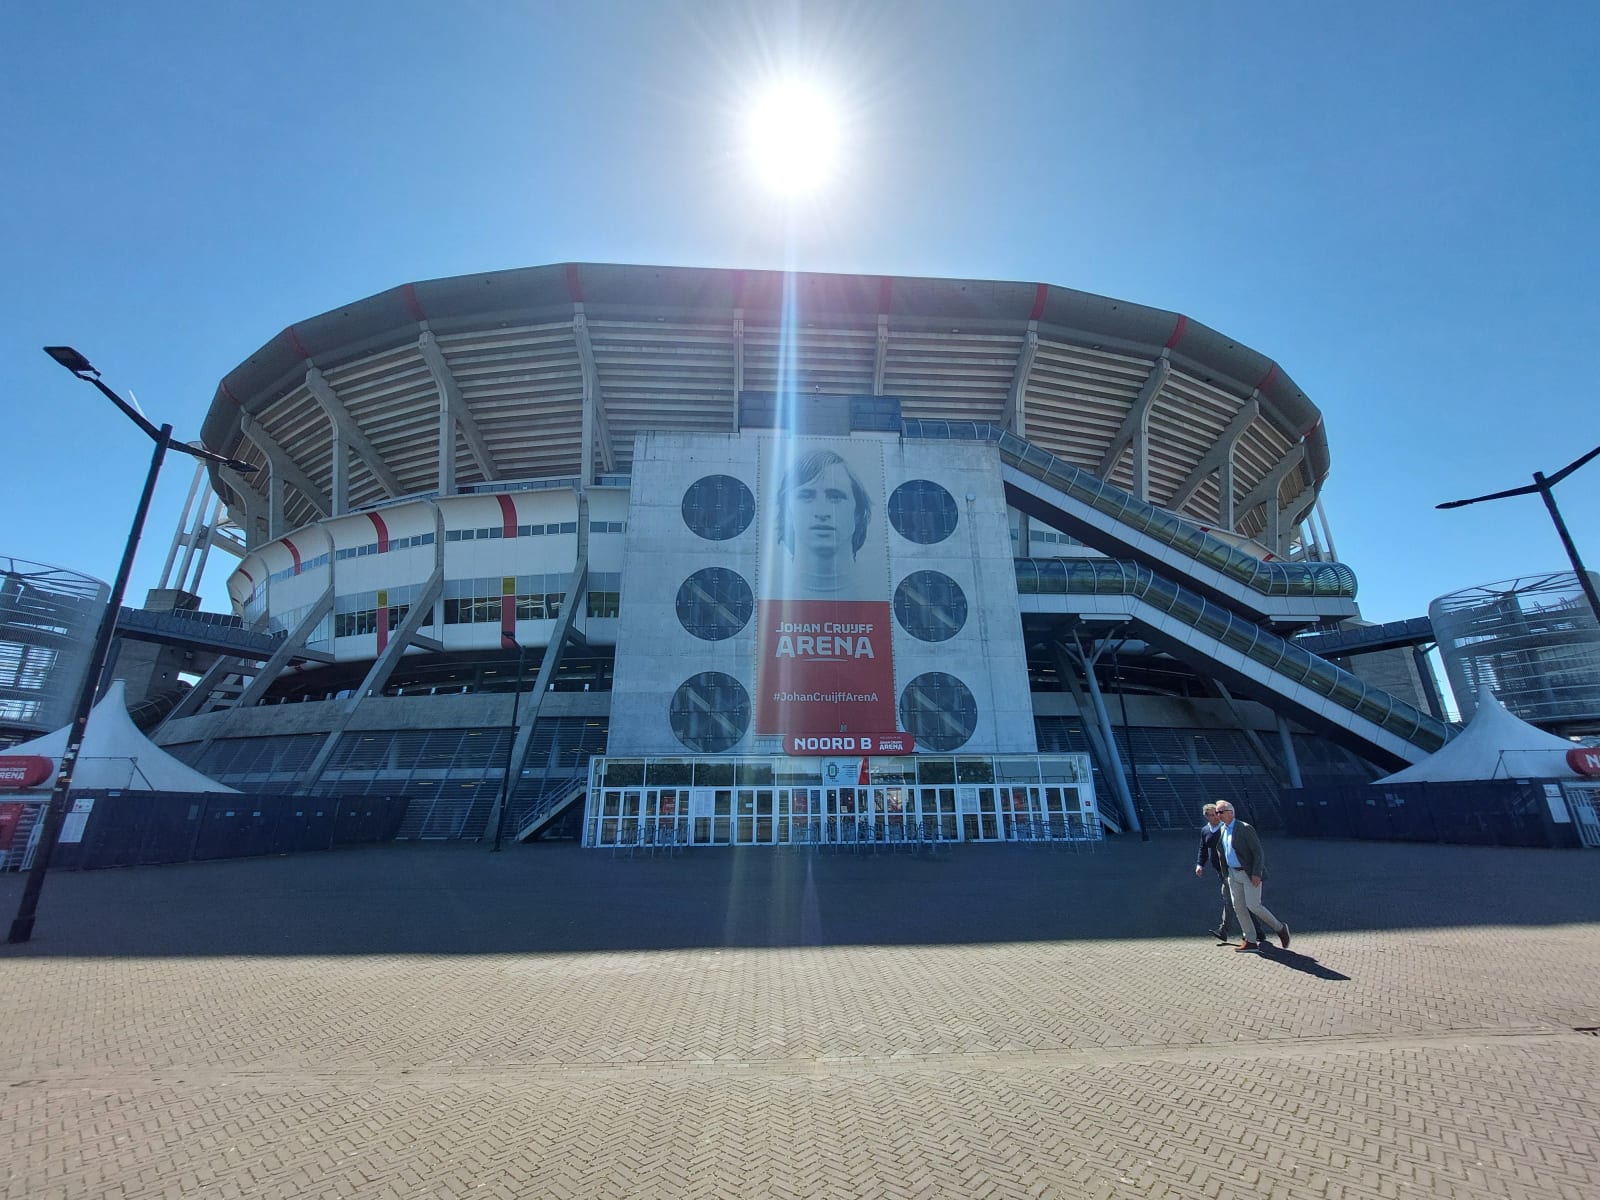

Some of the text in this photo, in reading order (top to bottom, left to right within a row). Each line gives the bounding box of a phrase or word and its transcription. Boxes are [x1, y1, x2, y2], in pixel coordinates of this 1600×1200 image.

[776, 622, 820, 633] JOHAN
[776, 636, 875, 658] ARENA
[773, 691, 879, 704] #JohanCruijffArenA
[794, 737, 872, 750] NOORD B
[1585, 754, 1600, 768] N
[0, 771, 25, 780] RENA
